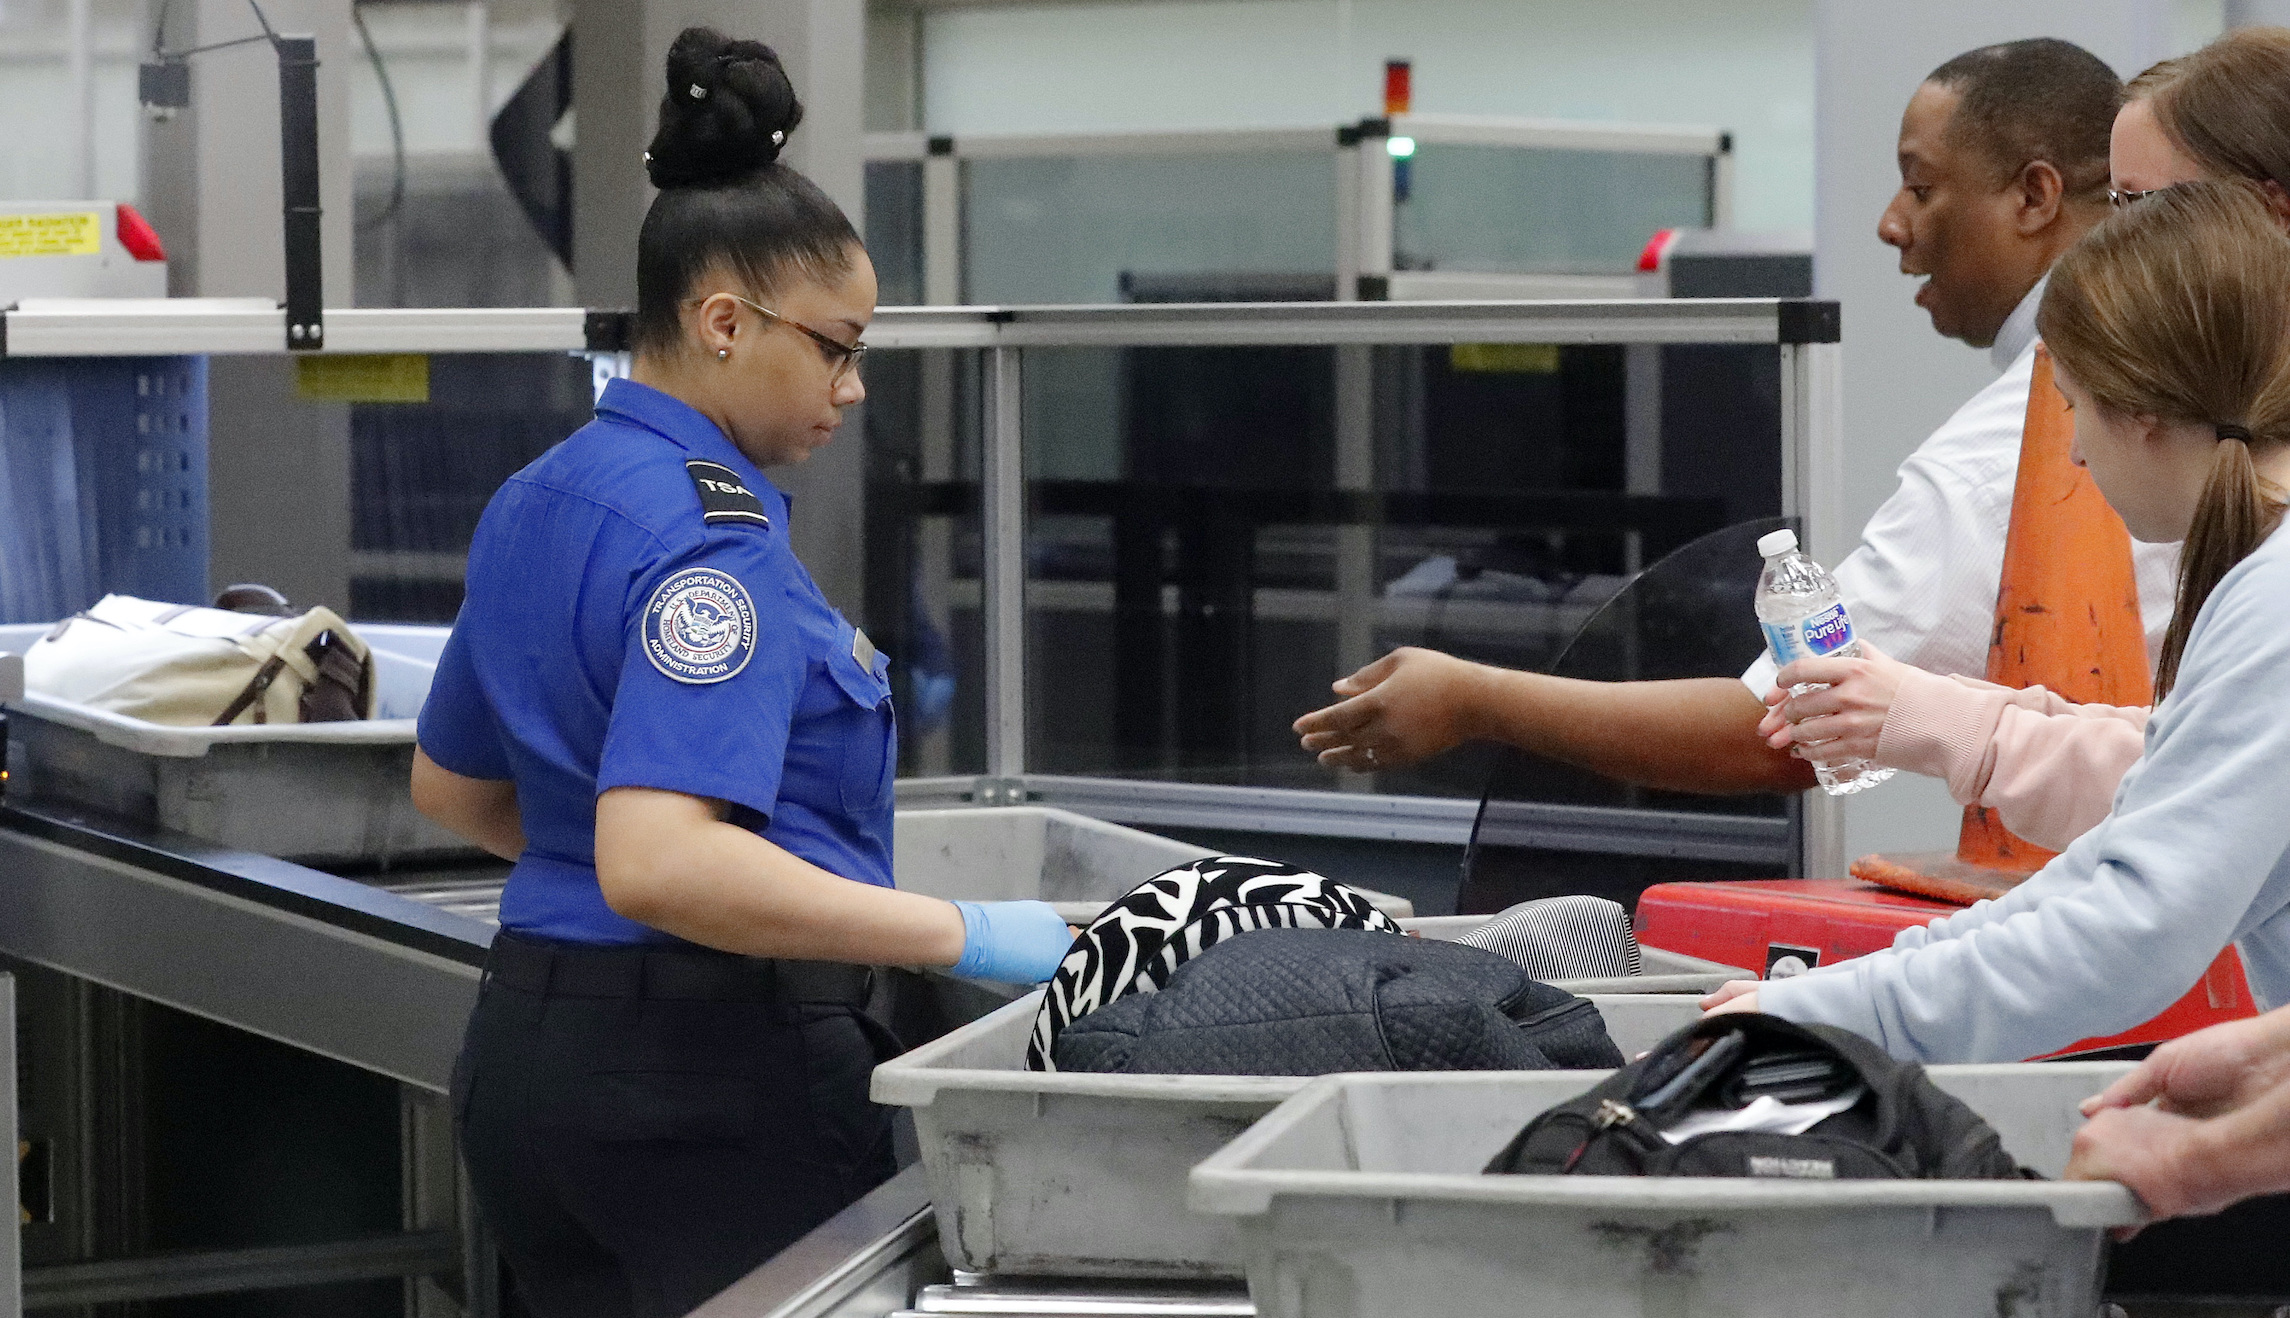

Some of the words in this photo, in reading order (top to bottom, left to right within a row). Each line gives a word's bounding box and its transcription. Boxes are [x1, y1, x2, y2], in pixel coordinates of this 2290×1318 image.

[652, 576, 738, 614] TRANSPORTATION
[736, 598, 752, 651] SECURITY
[688, 590, 737, 623] DEPARTMENT
[662, 619, 689, 657] HOMELAND
[692, 642, 732, 661] SECURITY
[1804, 622, 1836, 642] Pure
[649, 638, 729, 675] ADMINISTRATION
